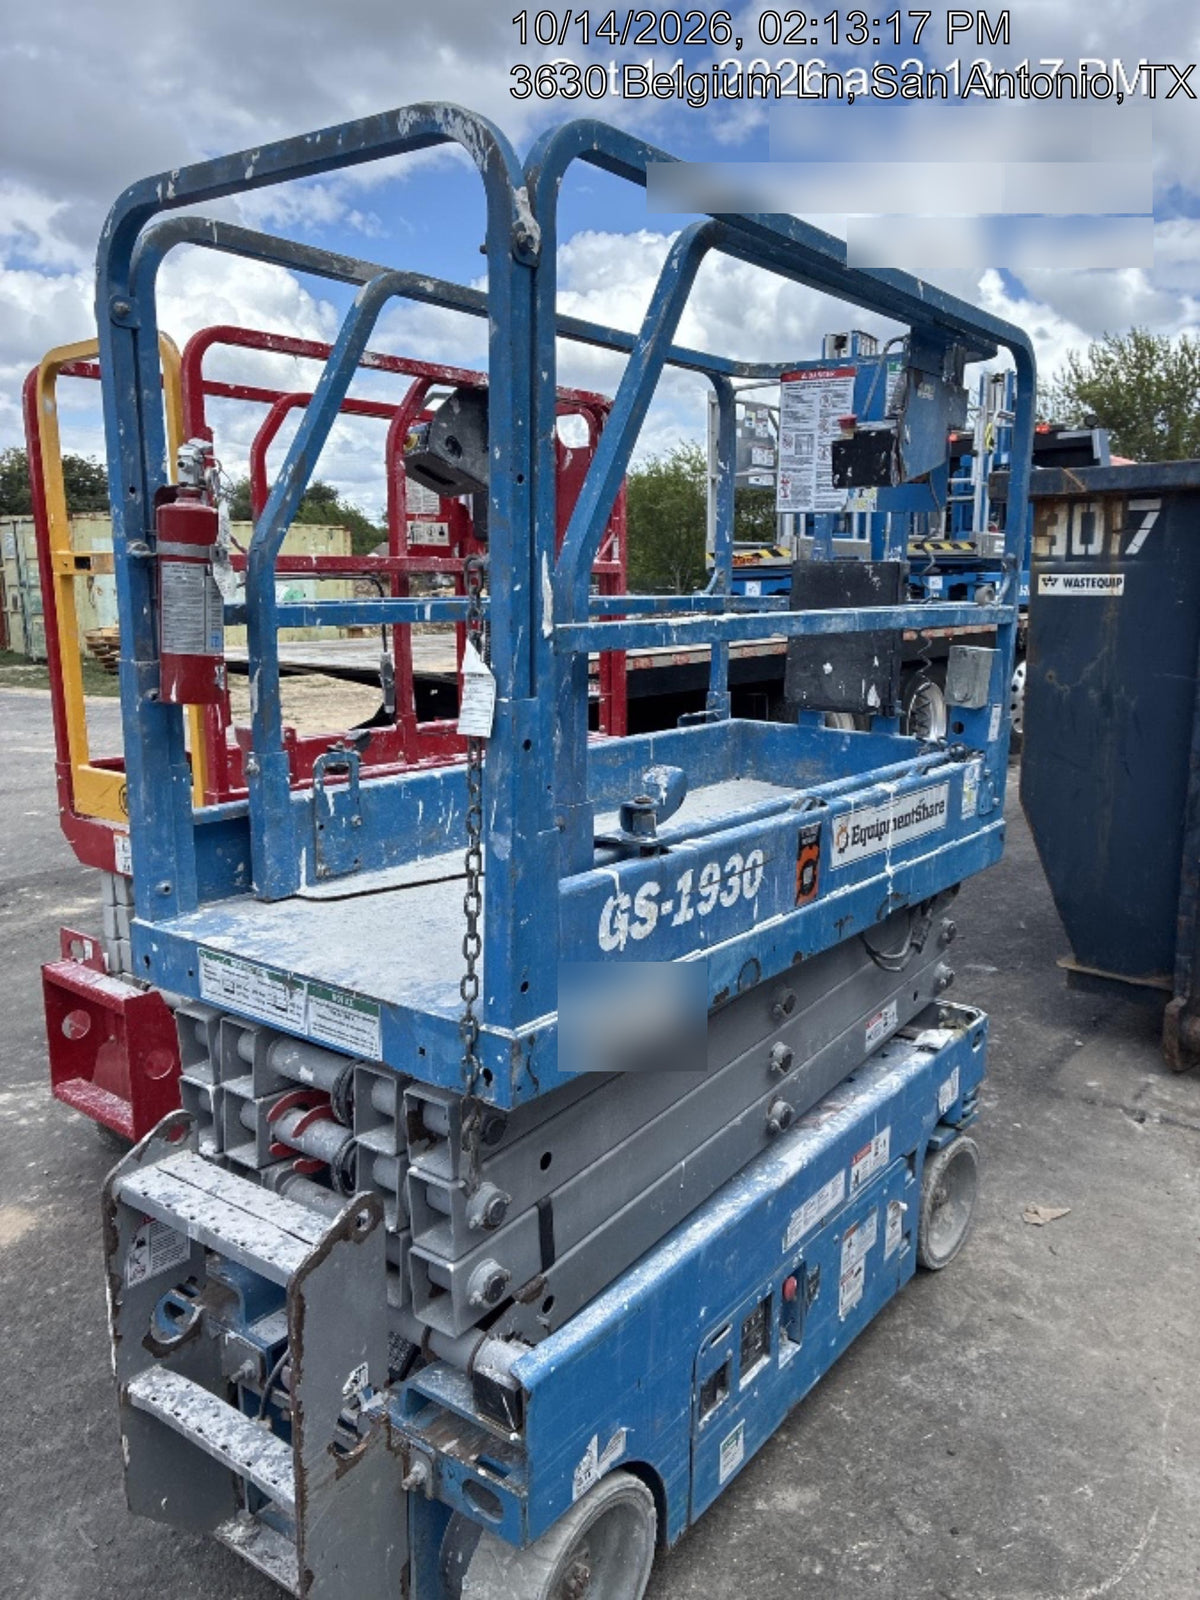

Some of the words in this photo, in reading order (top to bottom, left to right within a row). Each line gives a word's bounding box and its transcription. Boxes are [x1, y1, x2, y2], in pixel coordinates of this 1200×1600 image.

[1062, 576, 1123, 588] WASTEQUIP
[850, 798, 946, 847] EquipmentShare
[598, 849, 764, 951] GS-1930
